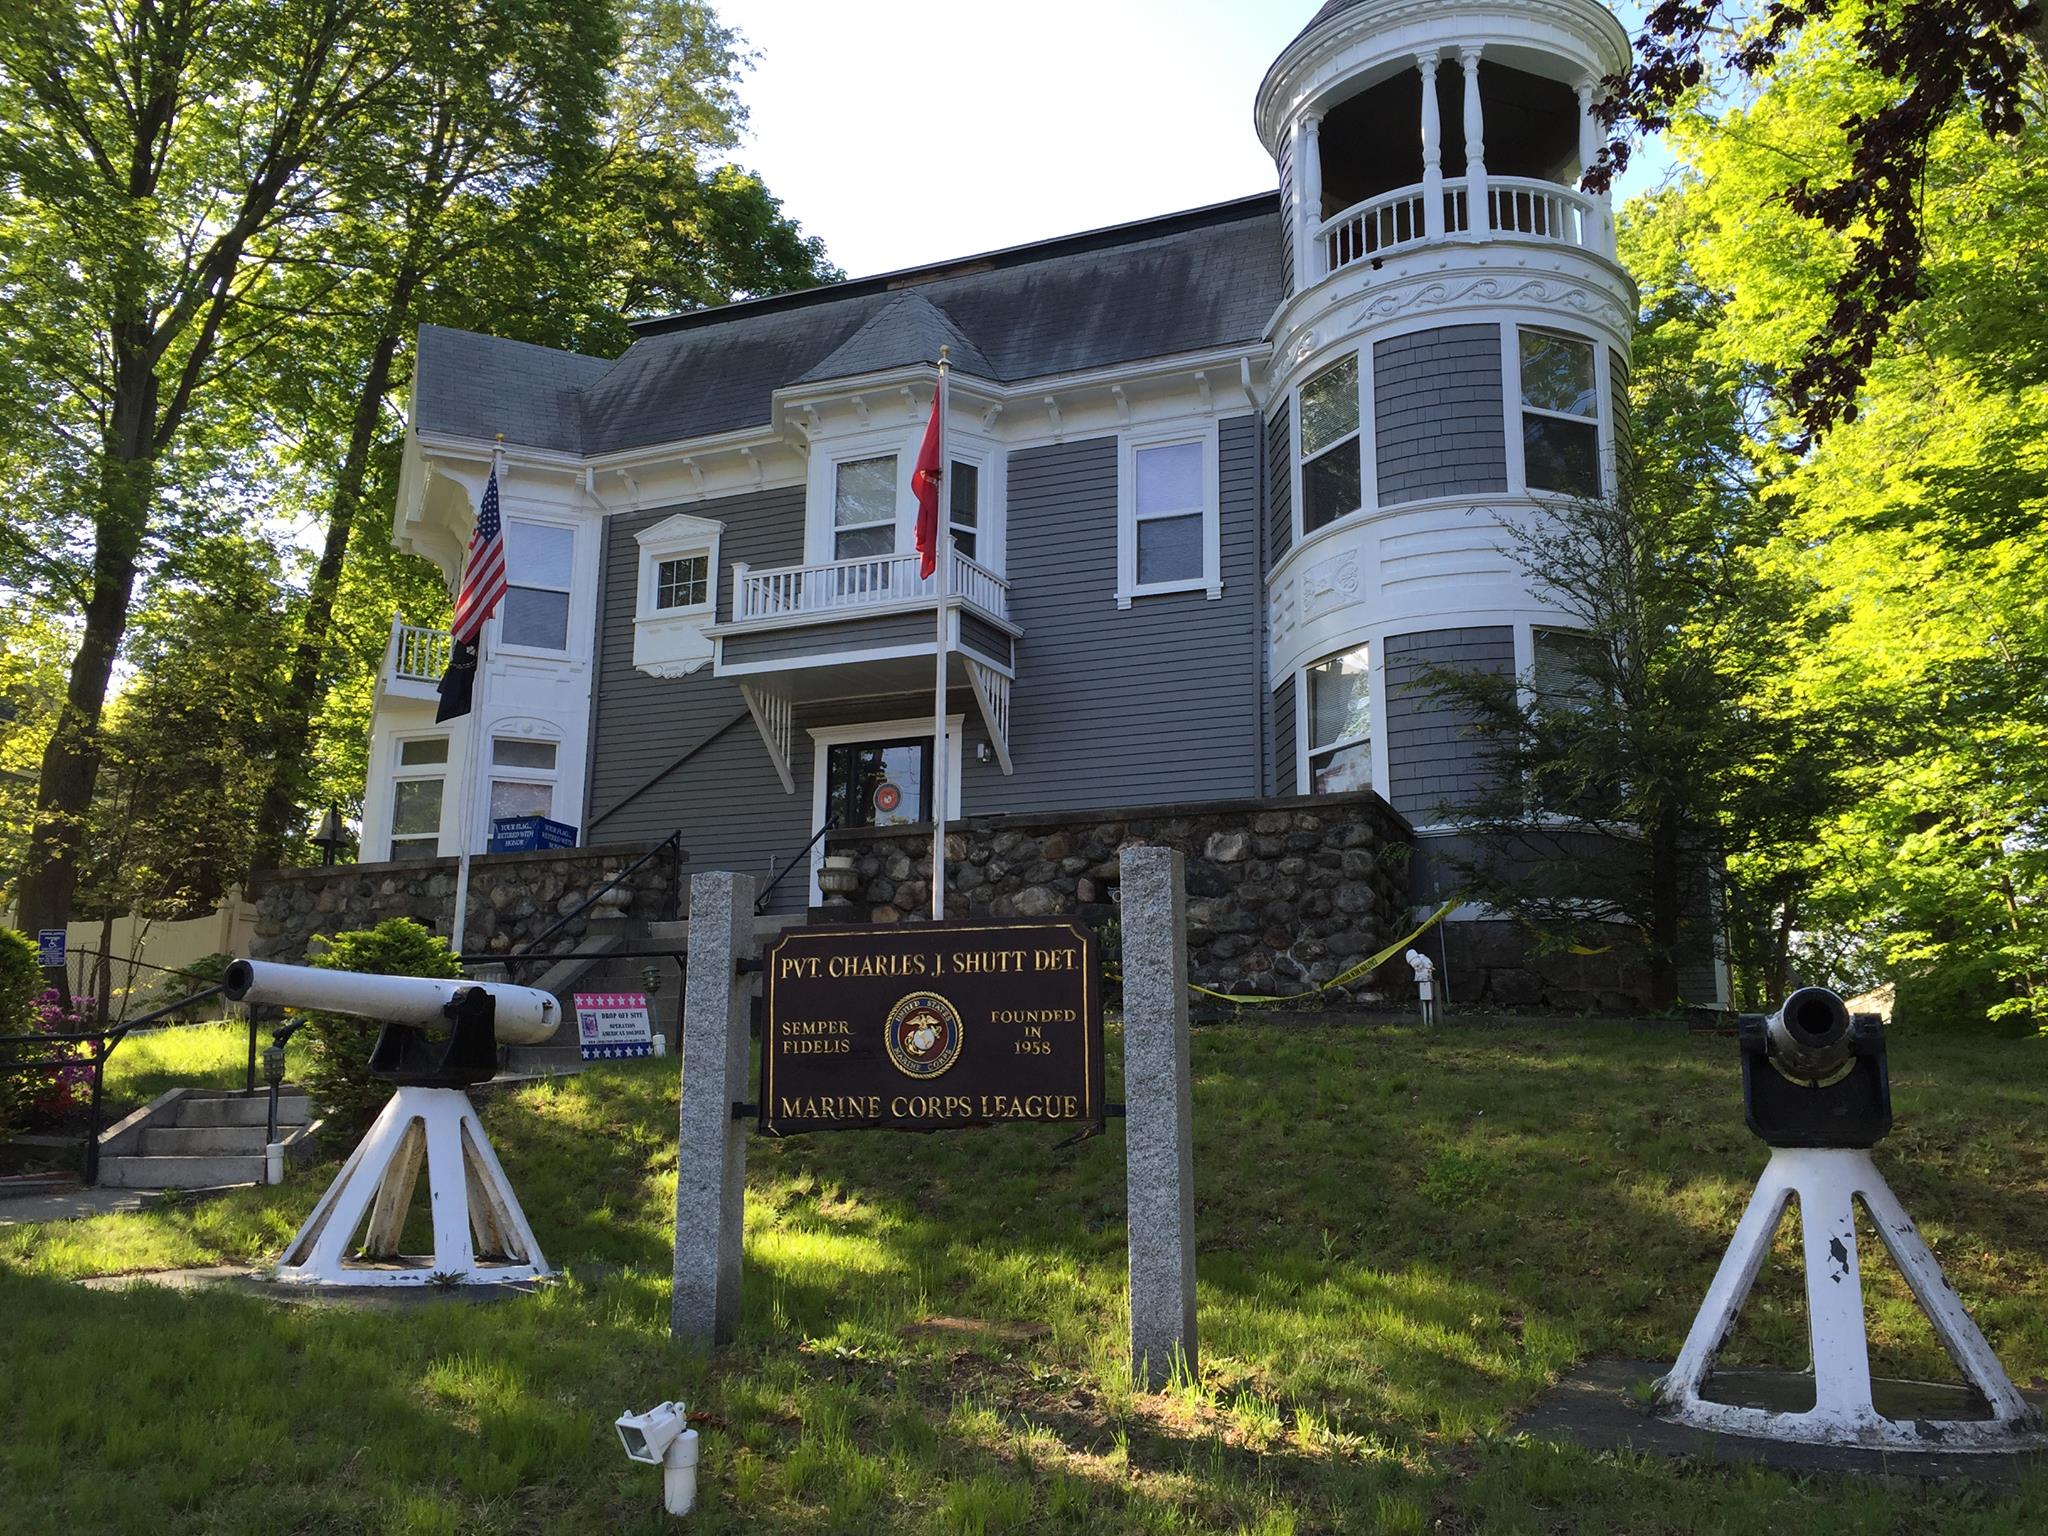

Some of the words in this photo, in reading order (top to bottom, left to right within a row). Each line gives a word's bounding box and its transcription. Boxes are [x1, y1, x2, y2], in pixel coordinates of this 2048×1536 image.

[780, 957, 823, 980] PVT.
[828, 953, 926, 978] CHARLES
[930, 952, 946, 977] J.
[952, 950, 1028, 974] SHUTT
[1034, 949, 1080, 972] DET.
[601, 1012, 617, 1020] DROP
[895, 1000, 921, 1022] UNITED
[926, 1000, 952, 1021] STATES
[991, 1009, 1077, 1024] FOUNDED
[782, 1020, 856, 1036] SEMPER
[1023, 1026, 1042, 1039] IN
[783, 1039, 851, 1055] FIDELIS
[1013, 1041, 1052, 1055] 1958
[894, 1047, 922, 1071] MARINE
[927, 1049, 952, 1071] CORPS
[780, 1096, 881, 1121] MARINE
[891, 1095, 972, 1119] CORPS
[980, 1095, 1079, 1119] LEAGUE
